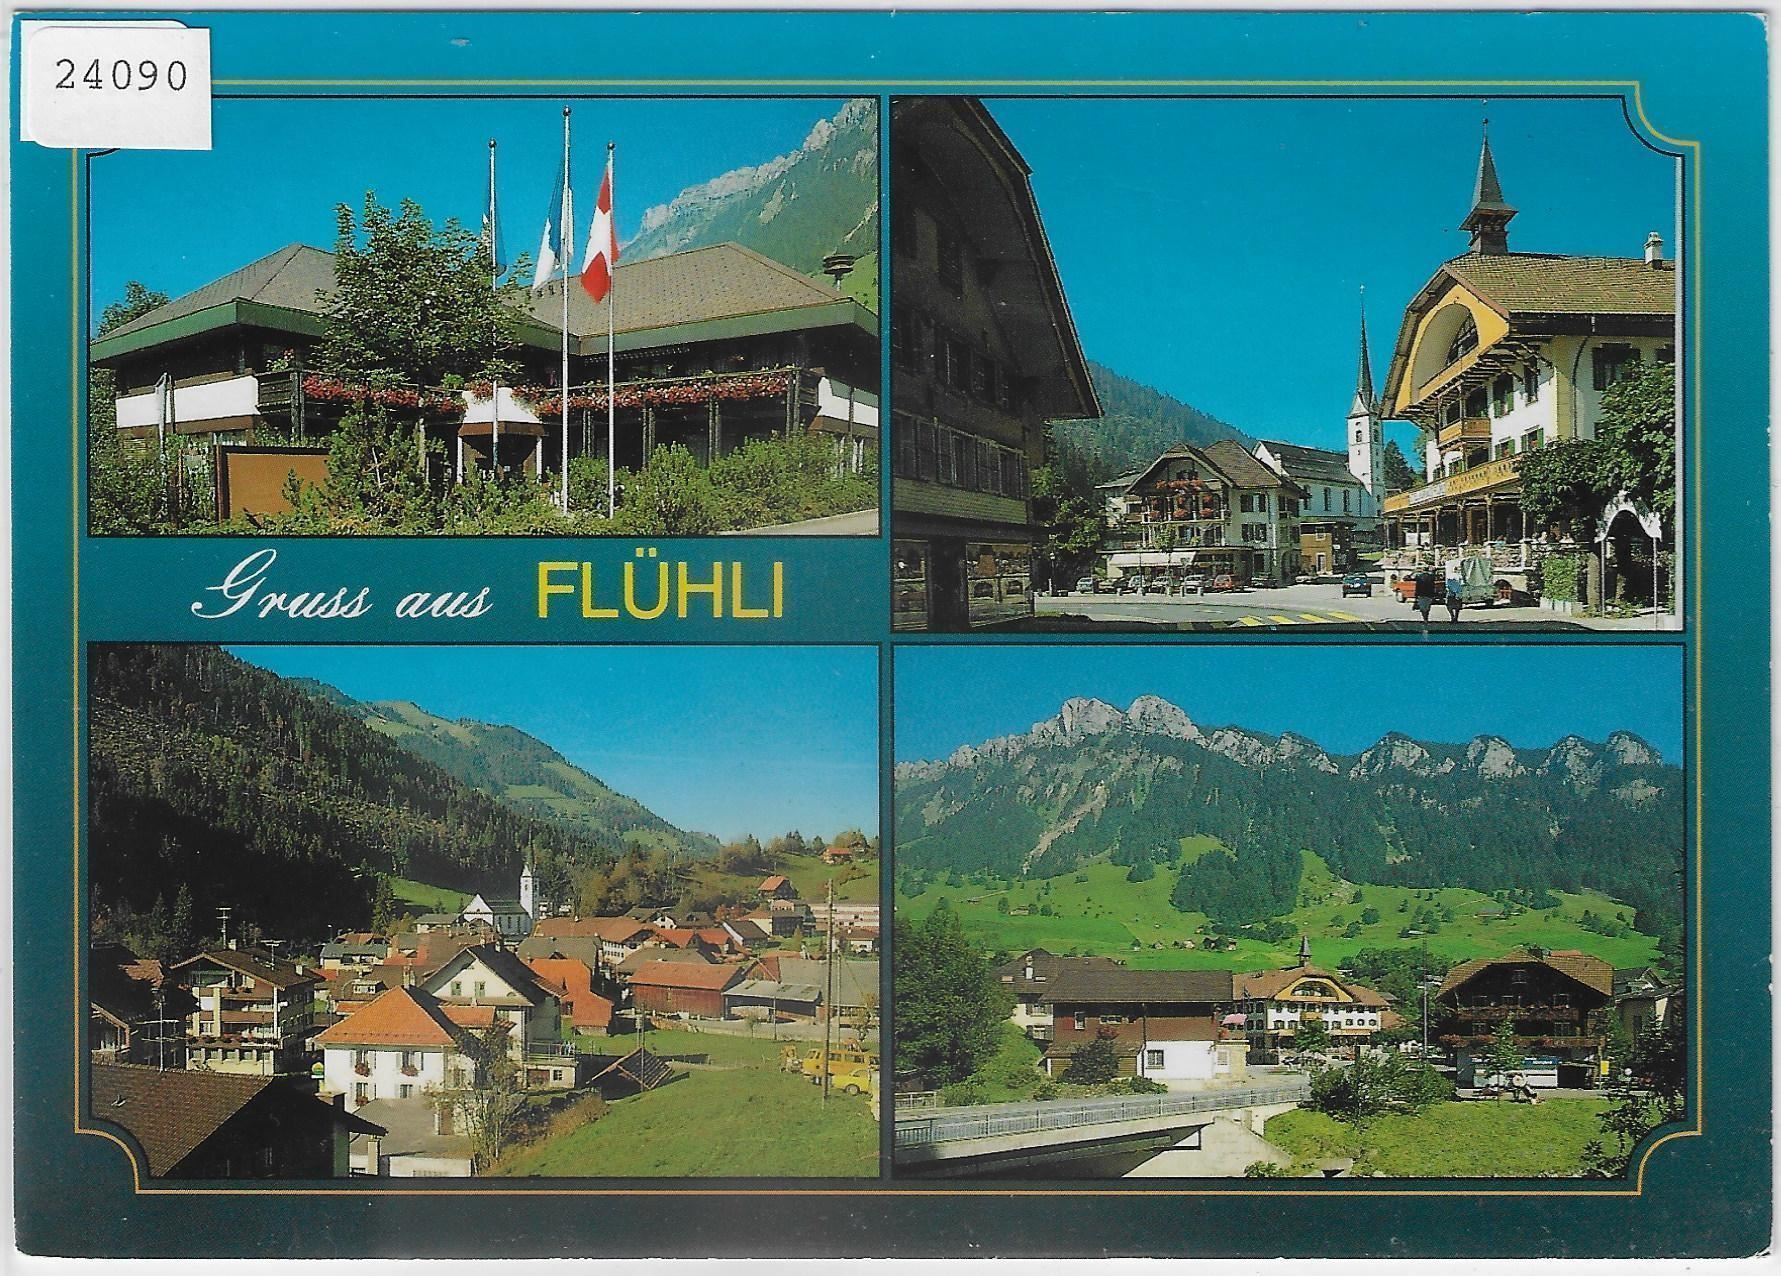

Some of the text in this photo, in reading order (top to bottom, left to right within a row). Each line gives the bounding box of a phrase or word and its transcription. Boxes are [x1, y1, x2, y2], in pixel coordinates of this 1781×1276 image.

[55, 58, 187, 91] 24090
[191, 547, 783, 620] Gruss aus FLÜHLI
